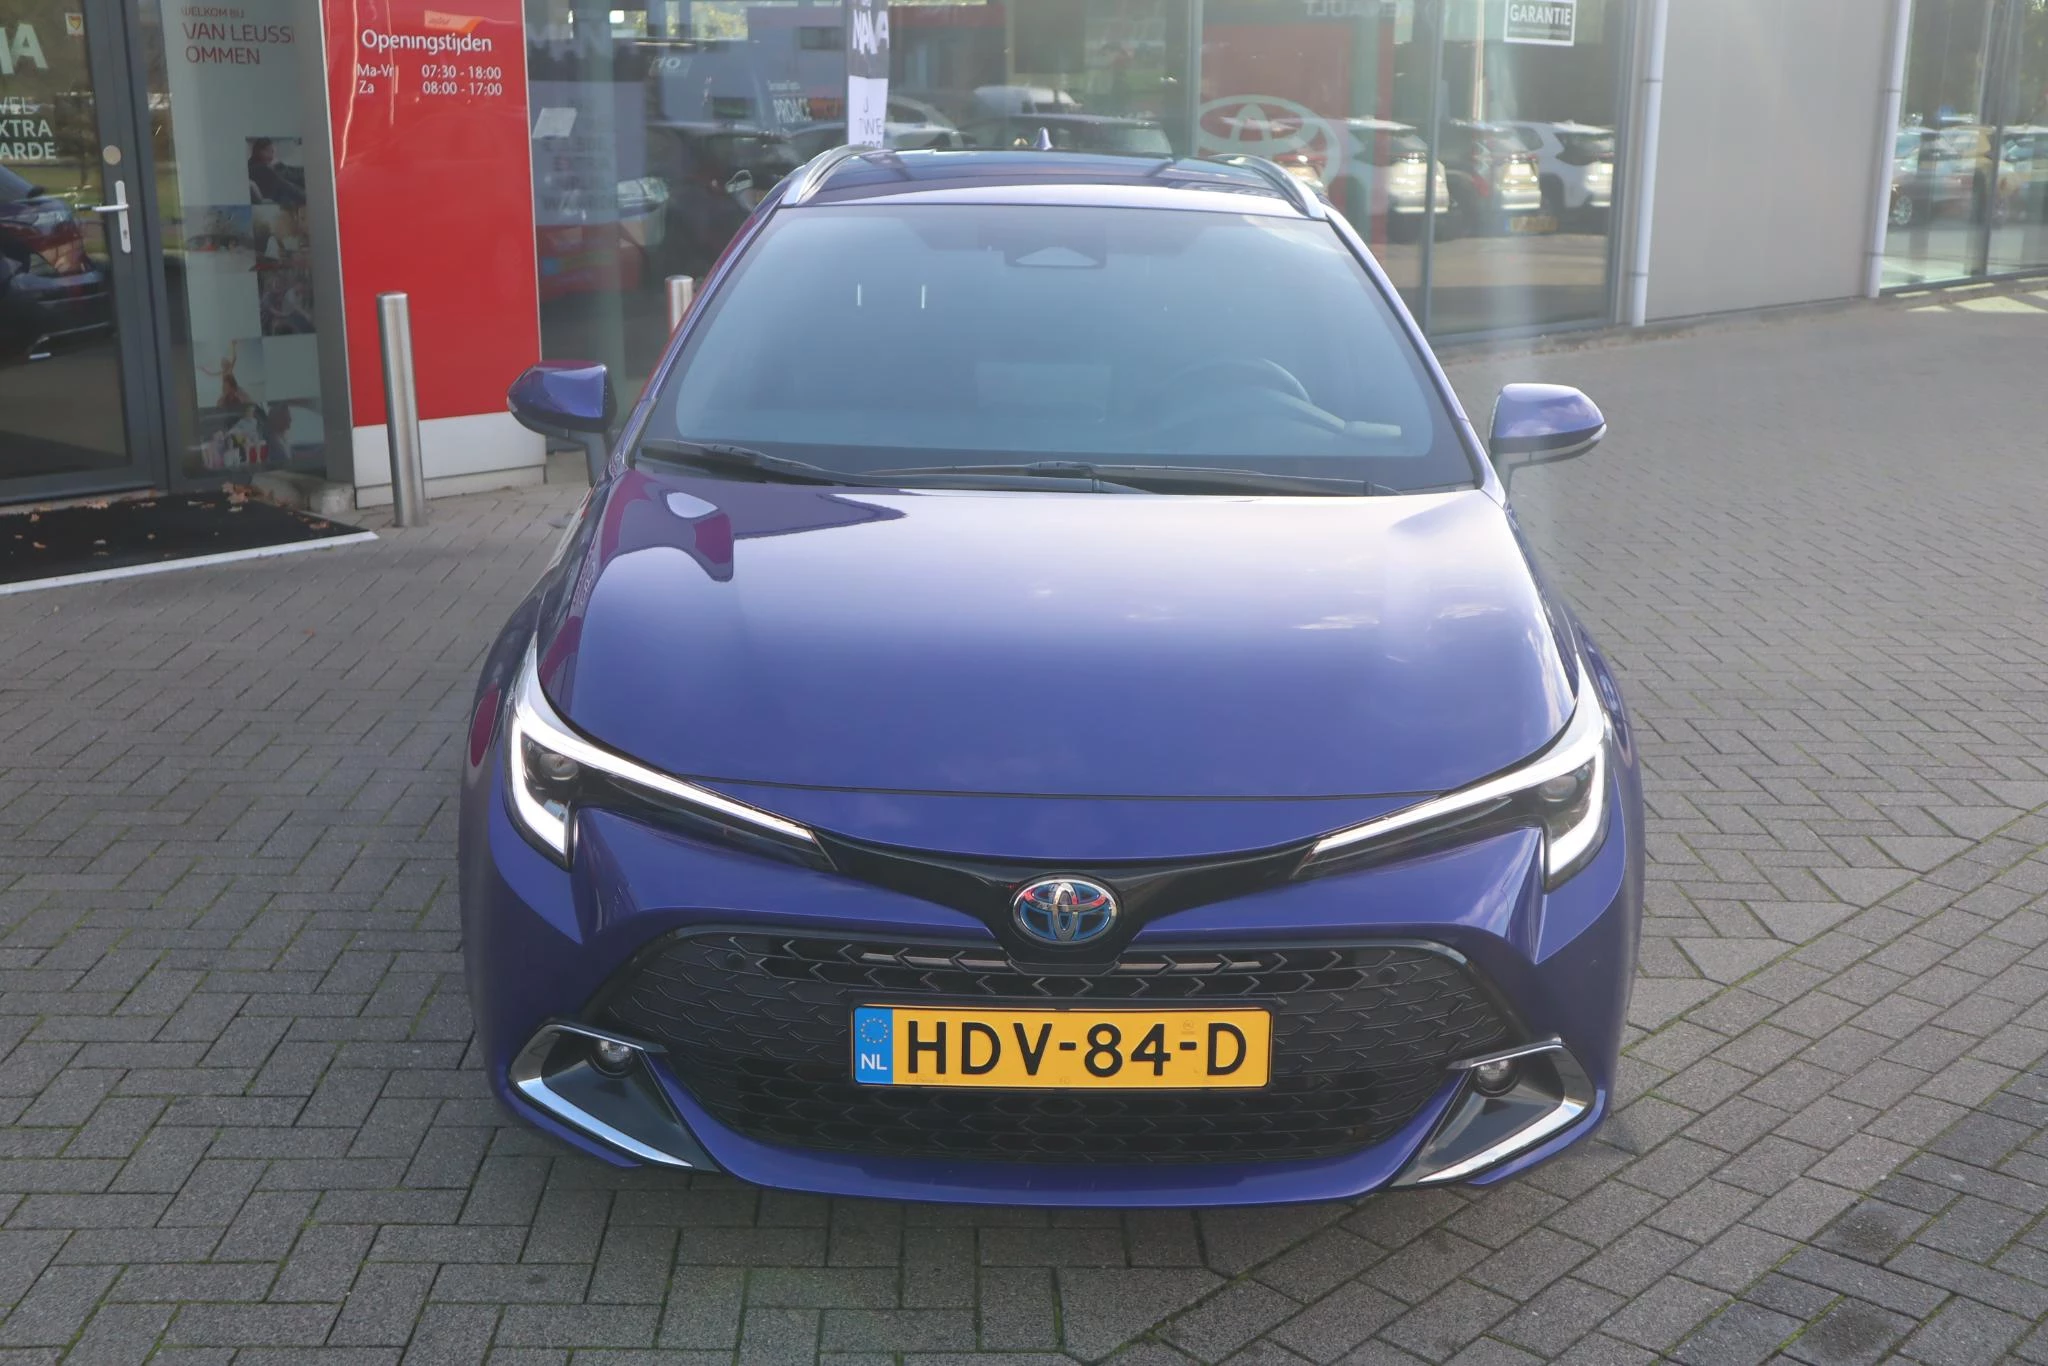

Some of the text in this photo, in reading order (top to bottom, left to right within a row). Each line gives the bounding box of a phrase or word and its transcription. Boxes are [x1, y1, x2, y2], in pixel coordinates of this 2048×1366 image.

[1509, 4, 1571, 26] GARANTIE
[183, 22, 295, 44] VAN LEUSS
[362, 29, 492, 56] Openingstijden
[186, 46, 260, 65] OMMEN
[357, 63, 394, 78] Ma-Vr
[422, 65, 456, 78] 07:30
[468, 65, 501, 80] 18:00
[359, 80, 374, 94] Za
[422, 81, 457, 95] 08:00
[469, 83, 502, 95] 17:00
[907, 1020, 1247, 1078] HDV-84-D
[860, 1053, 887, 1071] NL
